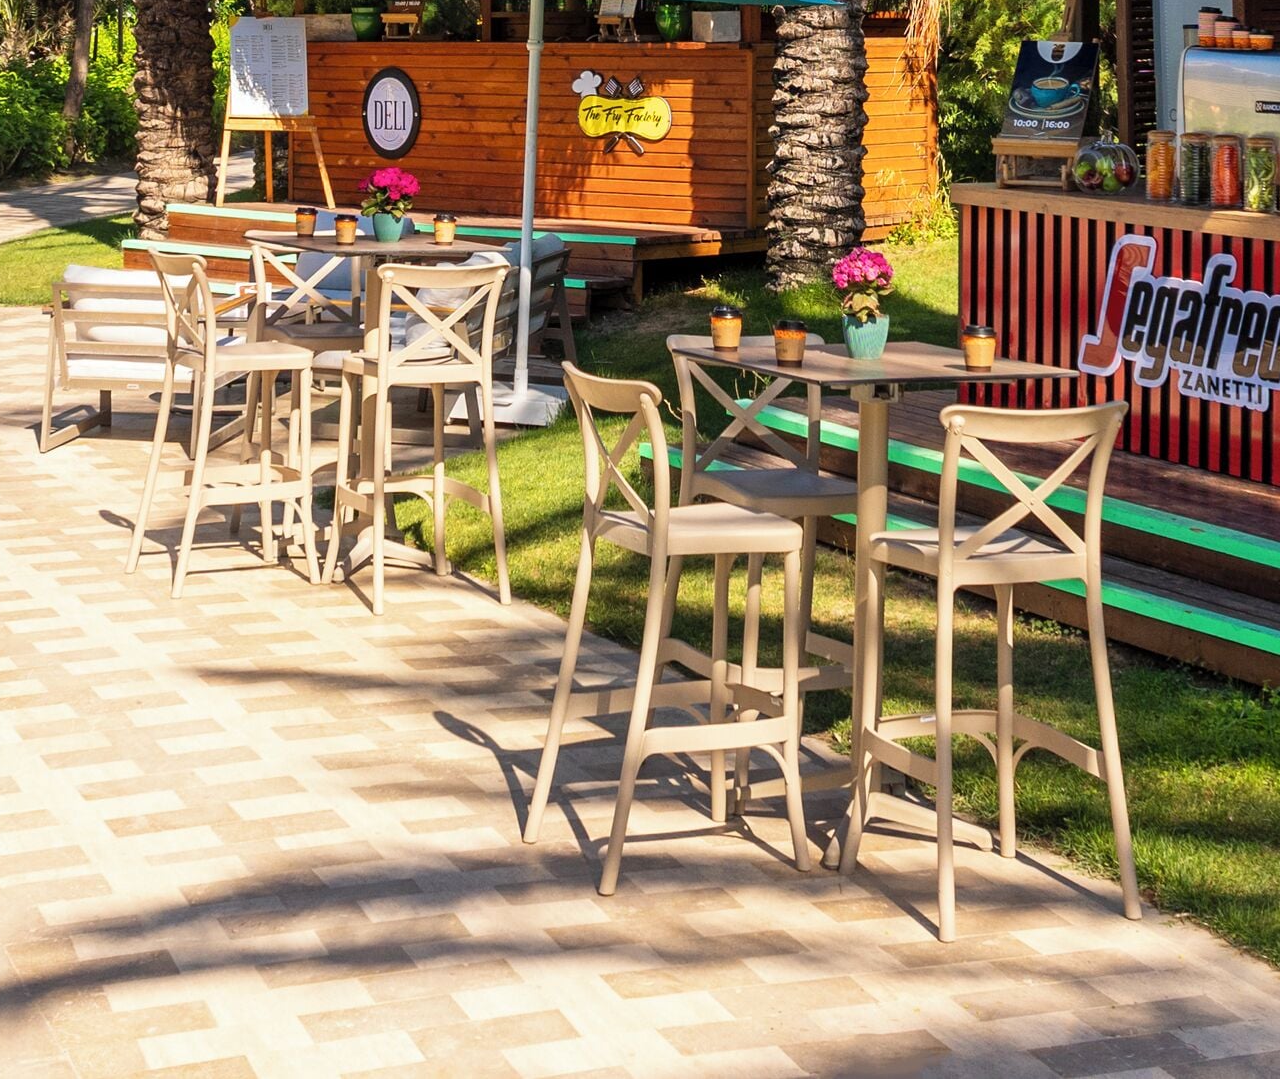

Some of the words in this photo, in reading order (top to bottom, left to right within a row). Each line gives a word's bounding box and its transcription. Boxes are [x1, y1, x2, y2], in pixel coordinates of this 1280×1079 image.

[374, 100, 406, 131] DELI
[582, 105, 602, 122] The
[603, 106, 623, 125] Fry
[624, 106, 661, 127] Factory
[1013, 119, 1038, 128] 10:00
[1045, 120, 1070, 129] 16:00
[1181, 370, 1263, 405] ZANETTI
